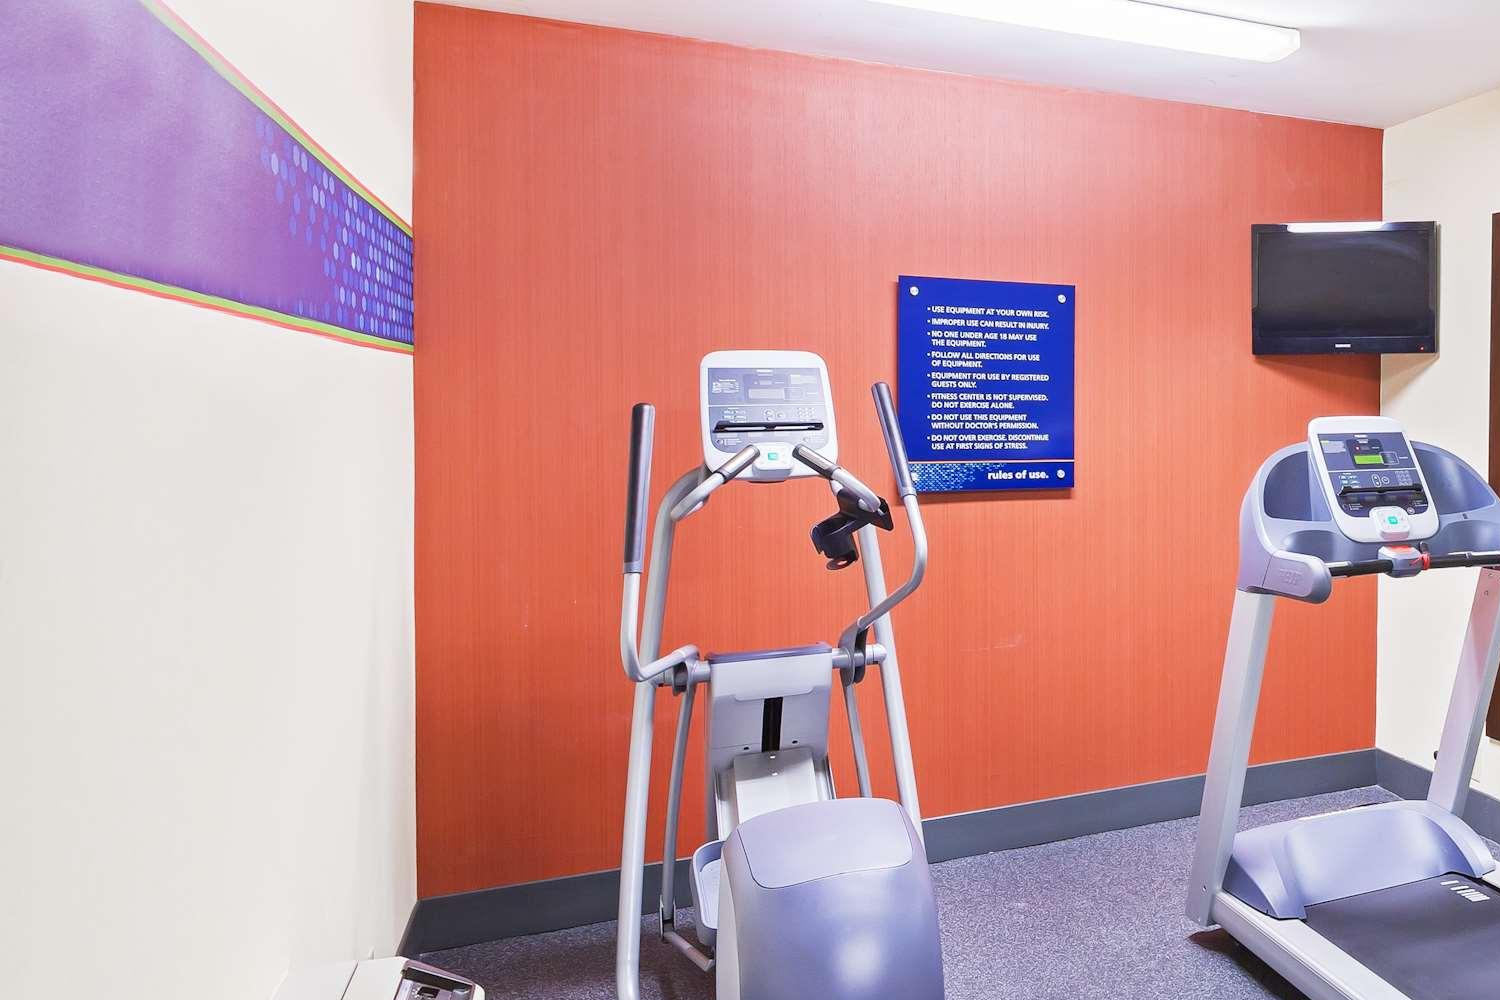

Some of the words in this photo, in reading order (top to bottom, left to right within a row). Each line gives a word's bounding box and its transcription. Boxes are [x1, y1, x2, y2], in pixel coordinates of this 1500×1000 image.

[946, 306, 985, 314] EQUIPMENT
[932, 318, 965, 326] IMPROPER
[943, 360, 982, 368] EQUIPMENT.
[932, 372, 972, 380] EQUIPMENT
[989, 414, 1027, 422] EQUIPMENT
[988, 470, 1013, 479] rules
[1015, 470, 1027, 479] of
